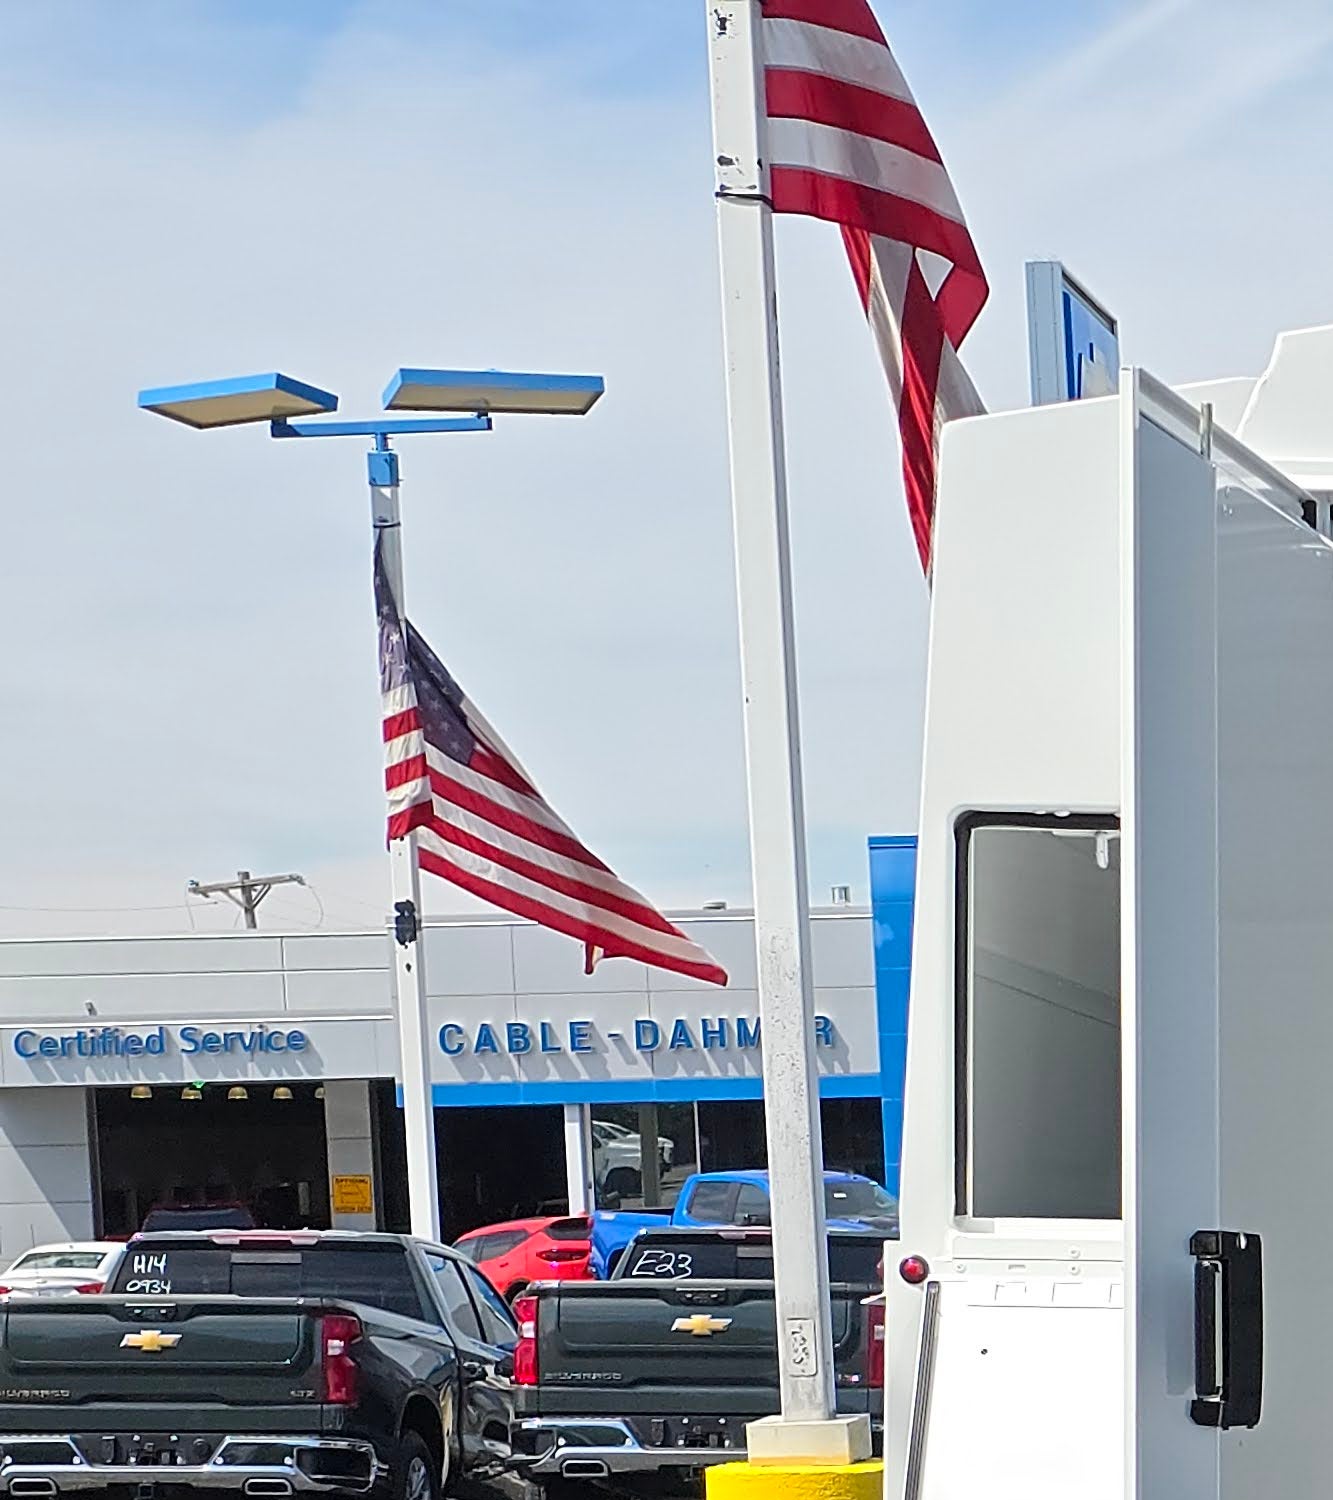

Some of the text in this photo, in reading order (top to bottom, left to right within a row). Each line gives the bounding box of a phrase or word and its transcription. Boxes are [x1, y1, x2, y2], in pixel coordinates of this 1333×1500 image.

[14, 1024, 306, 1059] Certified Service
[438, 1015, 833, 1056] CABLE-DAHMR
[133, 1253, 168, 1275] H14
[631, 1249, 692, 1280] E23
[125, 1279, 171, 1295] 0934
